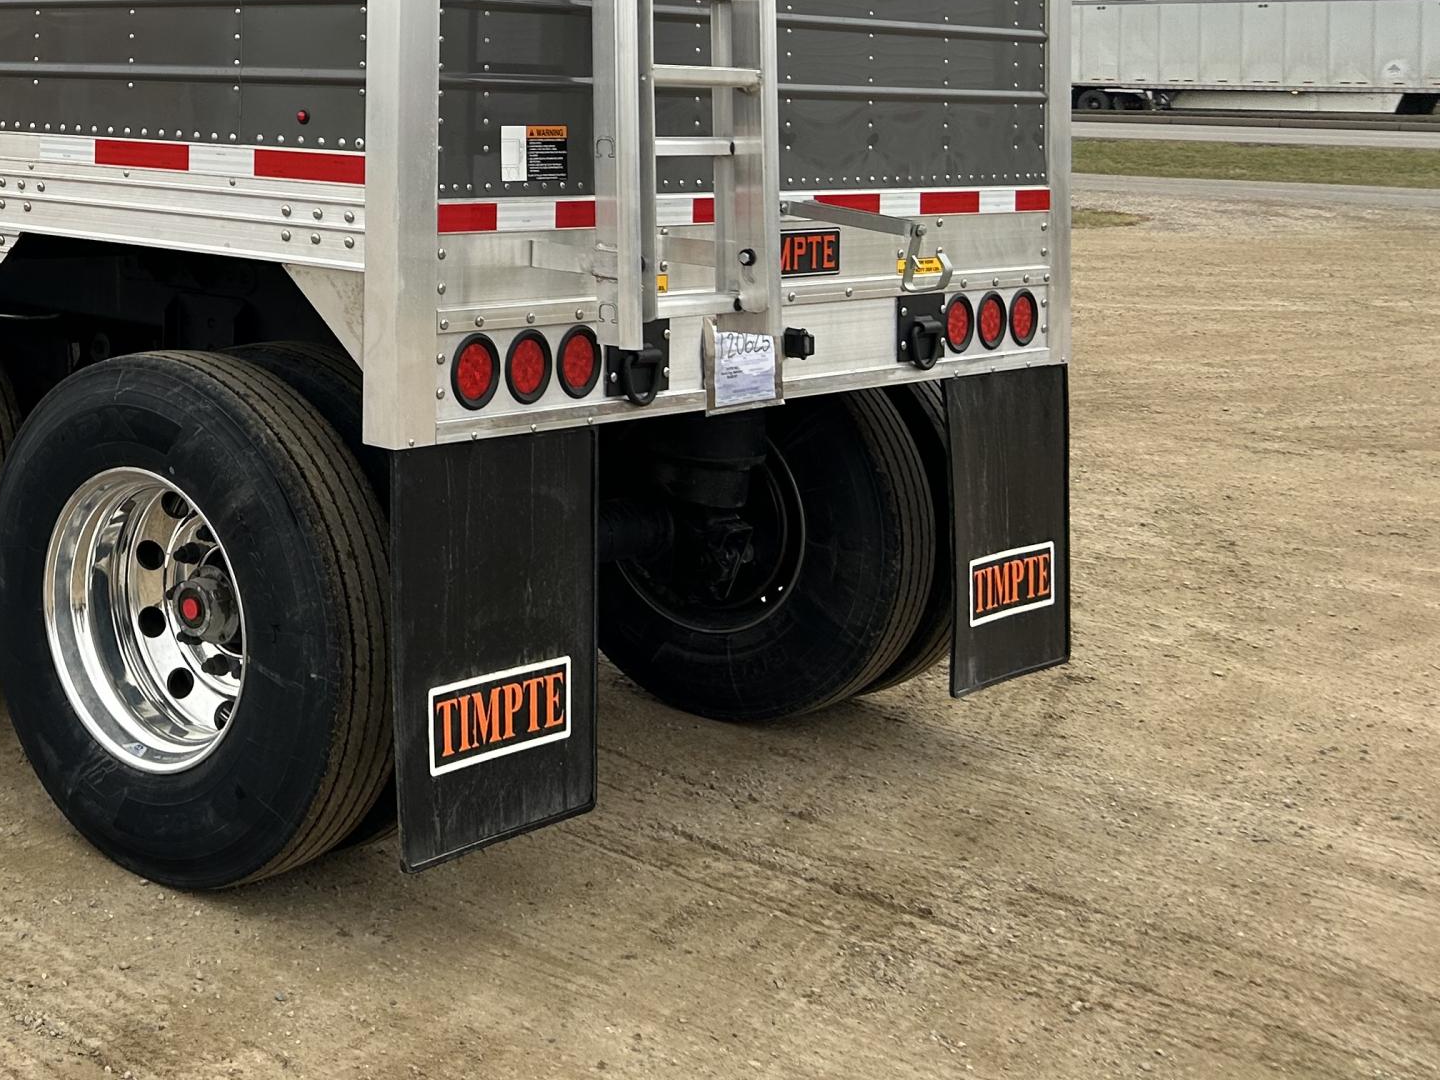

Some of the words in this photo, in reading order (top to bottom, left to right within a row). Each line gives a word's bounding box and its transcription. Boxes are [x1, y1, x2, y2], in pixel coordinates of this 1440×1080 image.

[780, 234, 836, 272] MPTE
[973, 553, 1050, 613] TIMPTE
[435, 671, 565, 758] TIMPTE
